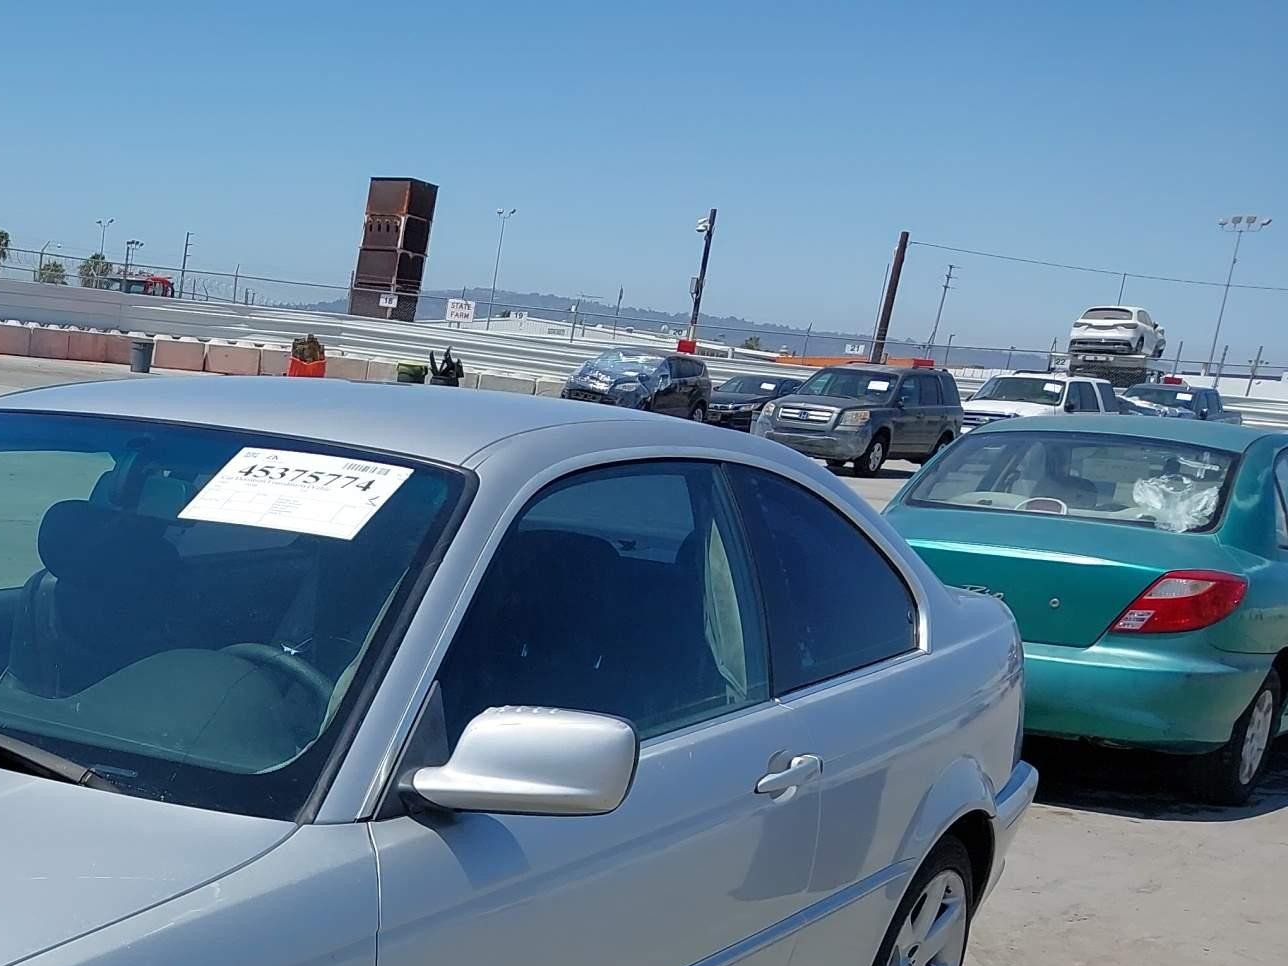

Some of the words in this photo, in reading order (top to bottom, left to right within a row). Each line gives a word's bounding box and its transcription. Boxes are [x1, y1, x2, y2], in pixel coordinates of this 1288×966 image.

[451, 302, 472, 311] STATE
[450, 311, 470, 319] FARM
[849, 344, 860, 352] 21
[1055, 358, 1066, 366] 22
[238, 463, 376, 492] 45375774
